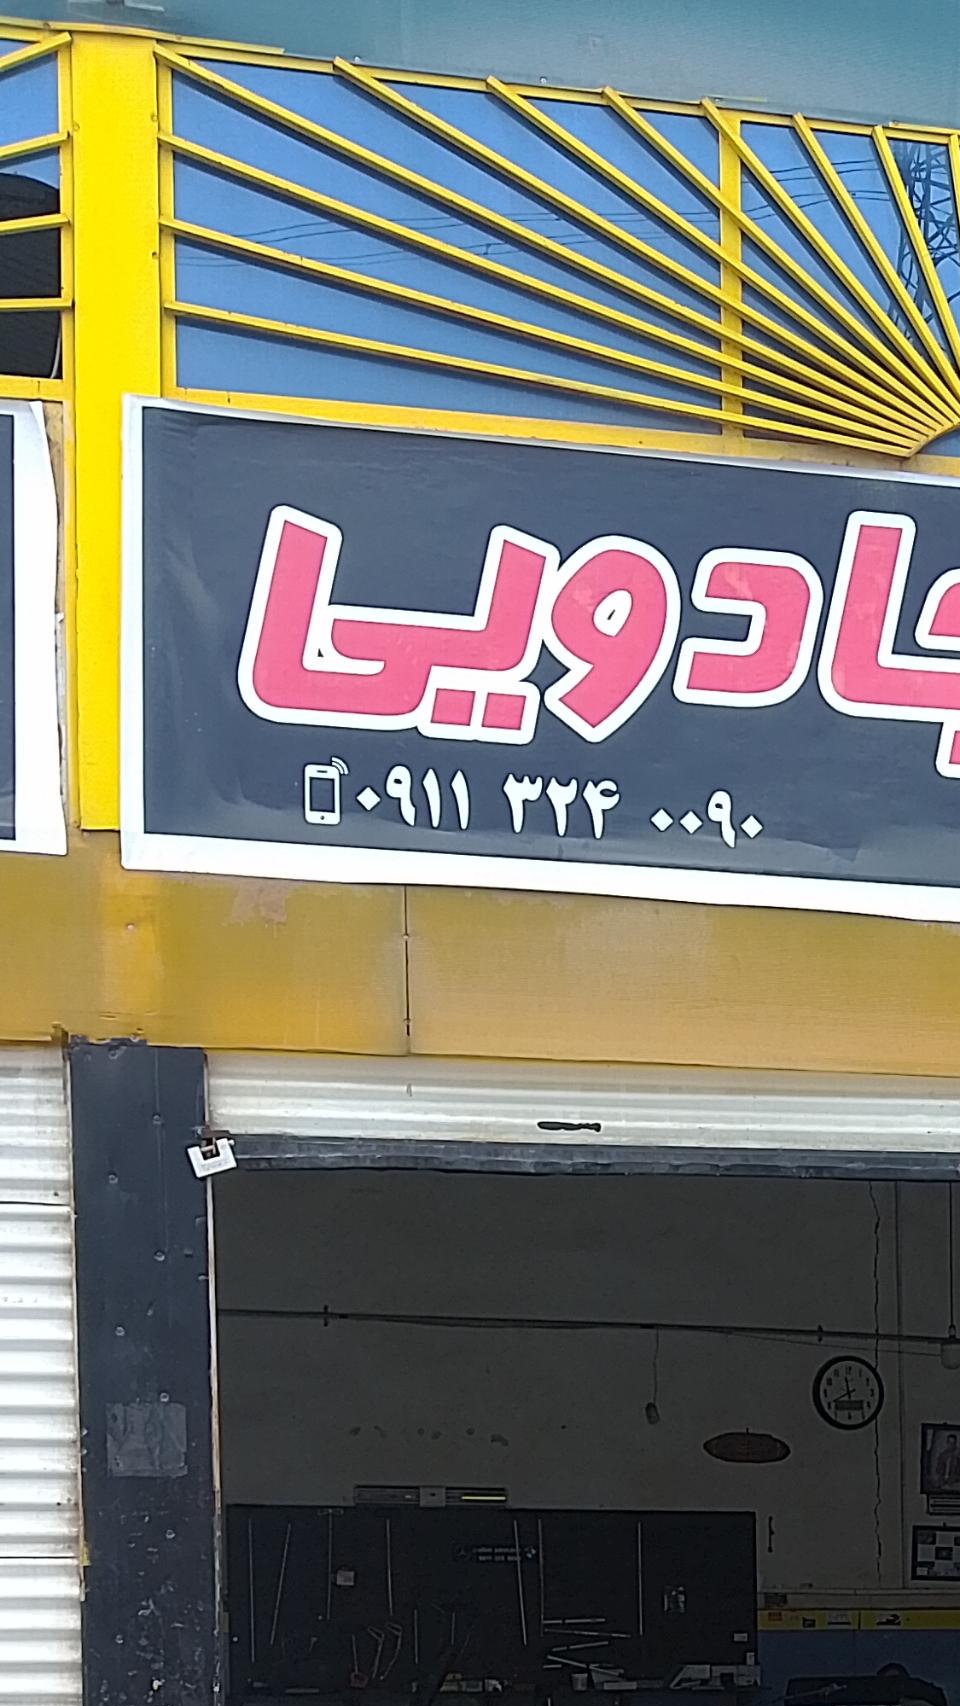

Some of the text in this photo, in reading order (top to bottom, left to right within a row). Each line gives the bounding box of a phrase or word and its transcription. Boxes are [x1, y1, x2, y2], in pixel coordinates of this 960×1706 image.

[357, 766, 763, 848] ۰۹۱۱ ۳۲۴ ۰۰۹۰
